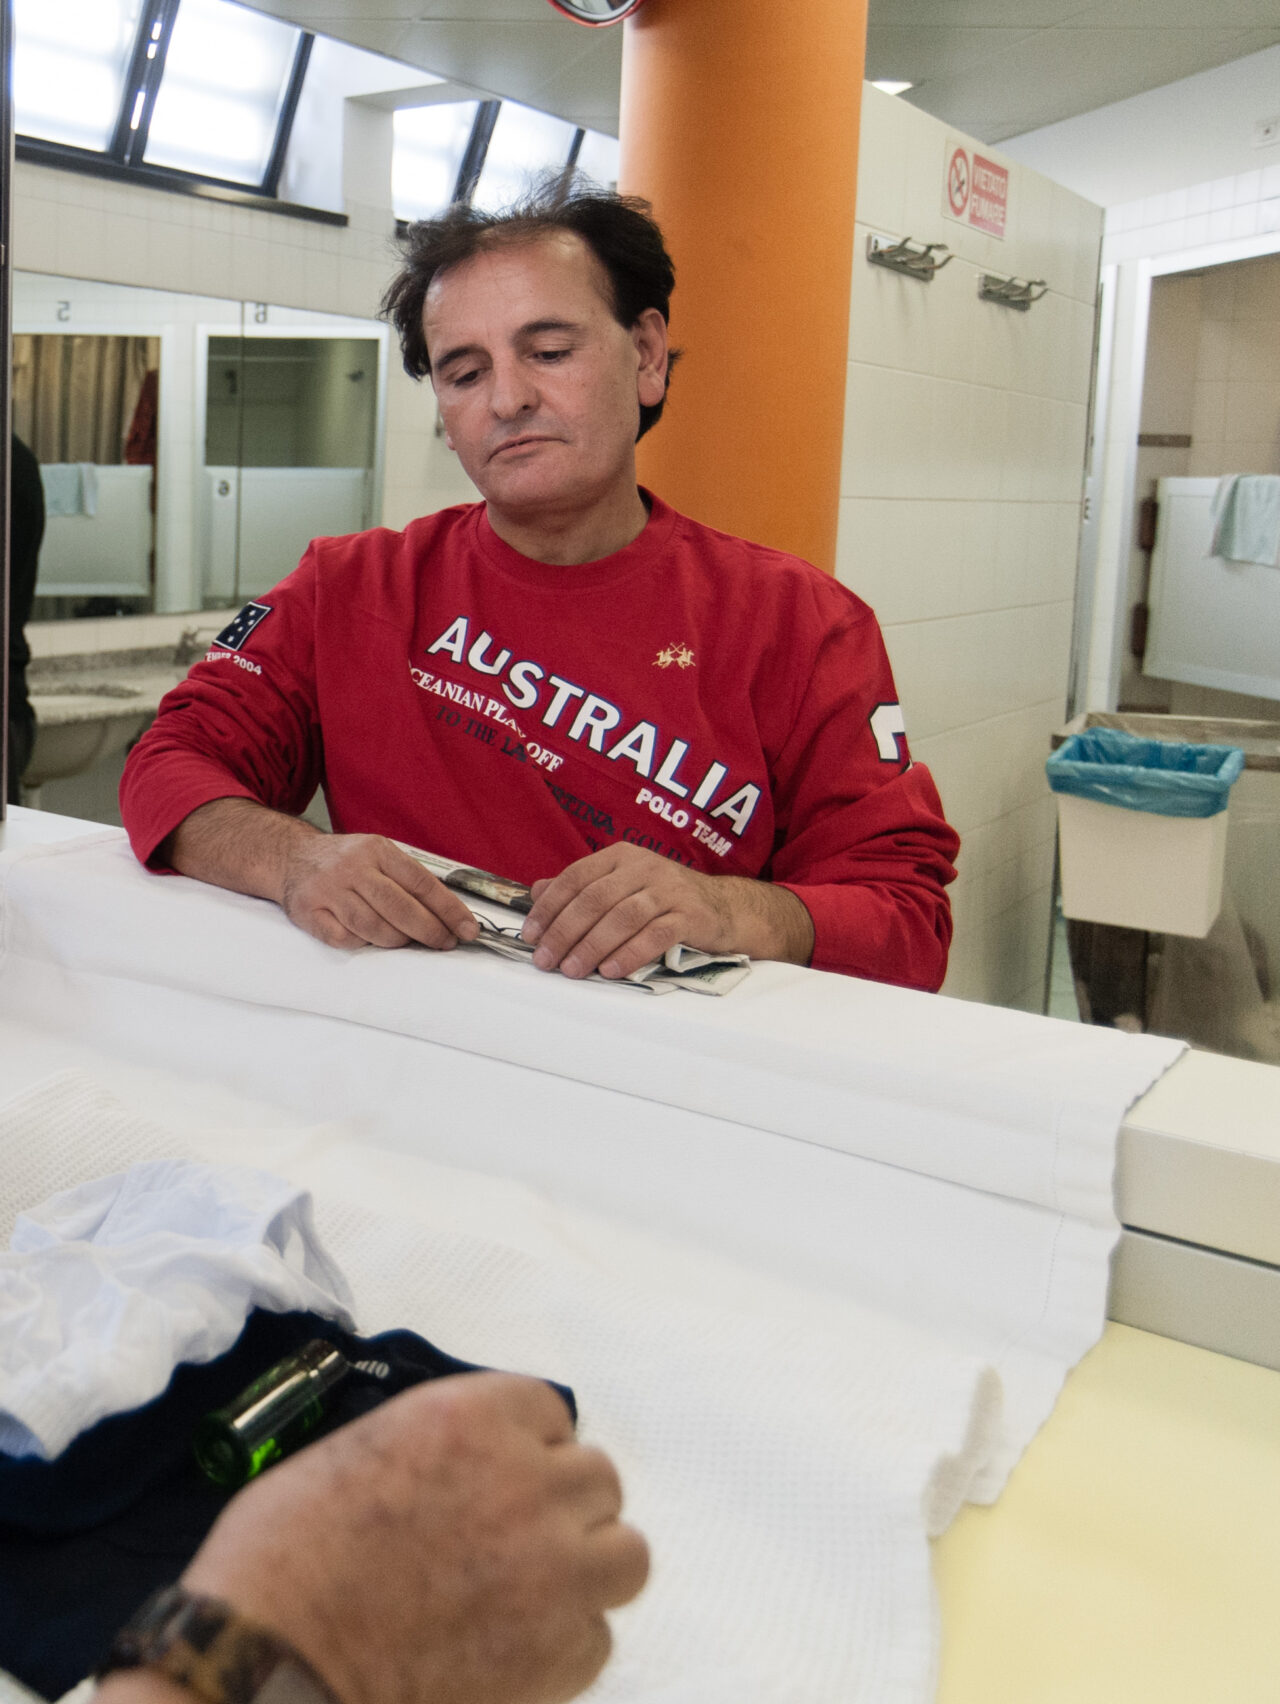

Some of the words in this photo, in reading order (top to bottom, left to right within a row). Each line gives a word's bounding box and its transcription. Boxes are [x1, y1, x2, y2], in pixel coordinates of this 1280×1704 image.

[974, 165, 1006, 200] VIETATO
[971, 192, 1005, 226] FUMARE
[233, 655, 263, 675] 2004
[408, 658, 485, 713] CEANIAN
[525, 741, 565, 773] OFF
[425, 614, 764, 839] AUSTRALIA
[435, 704, 462, 728] TO
[463, 716, 499, 746] THE
[635, 787, 690, 829] POLO
[691, 819, 733, 857] TEAM
